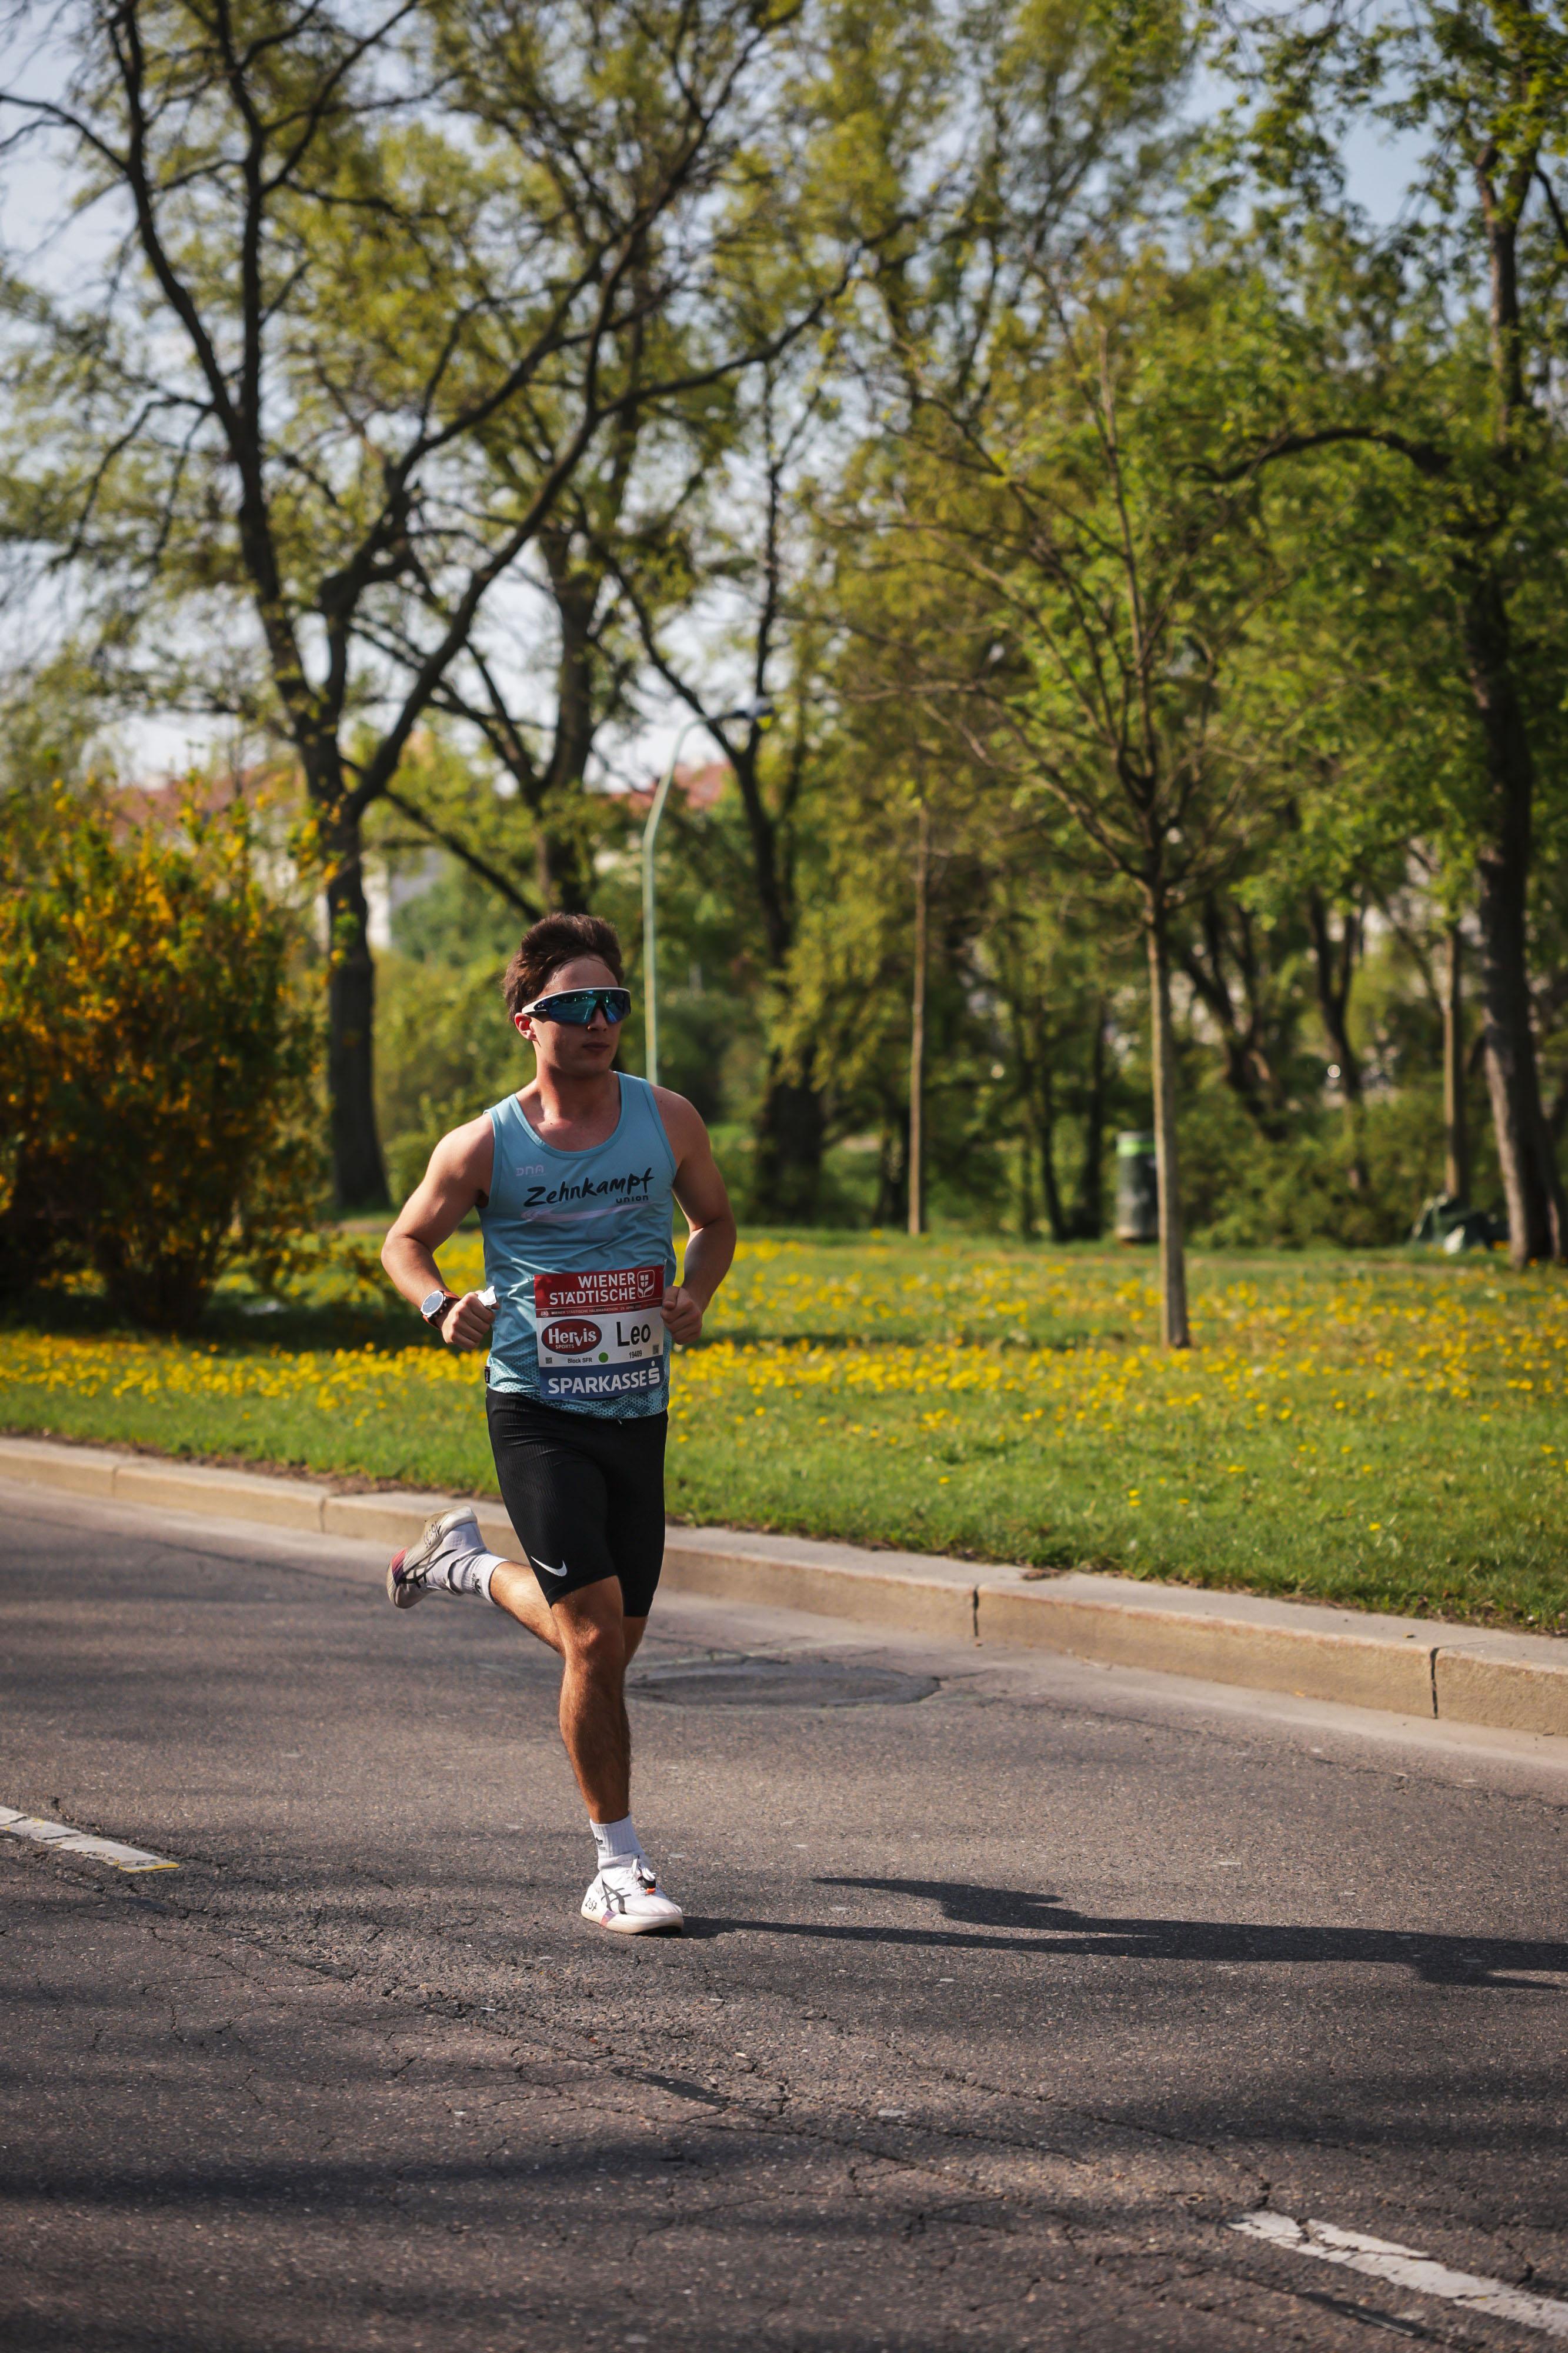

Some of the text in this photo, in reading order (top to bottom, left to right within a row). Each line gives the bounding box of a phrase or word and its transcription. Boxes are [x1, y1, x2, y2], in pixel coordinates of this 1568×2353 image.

[523, 1167, 655, 1207] Zehnkampf
[616, 1195, 649, 1204] union
[578, 1272, 636, 1288] WIENER
[549, 1287, 636, 1305] STÄDTISCHE
[548, 1328, 597, 1347] Hervis
[616, 1321, 651, 1347] Leo
[548, 1370, 646, 1394] SPARKASSE
